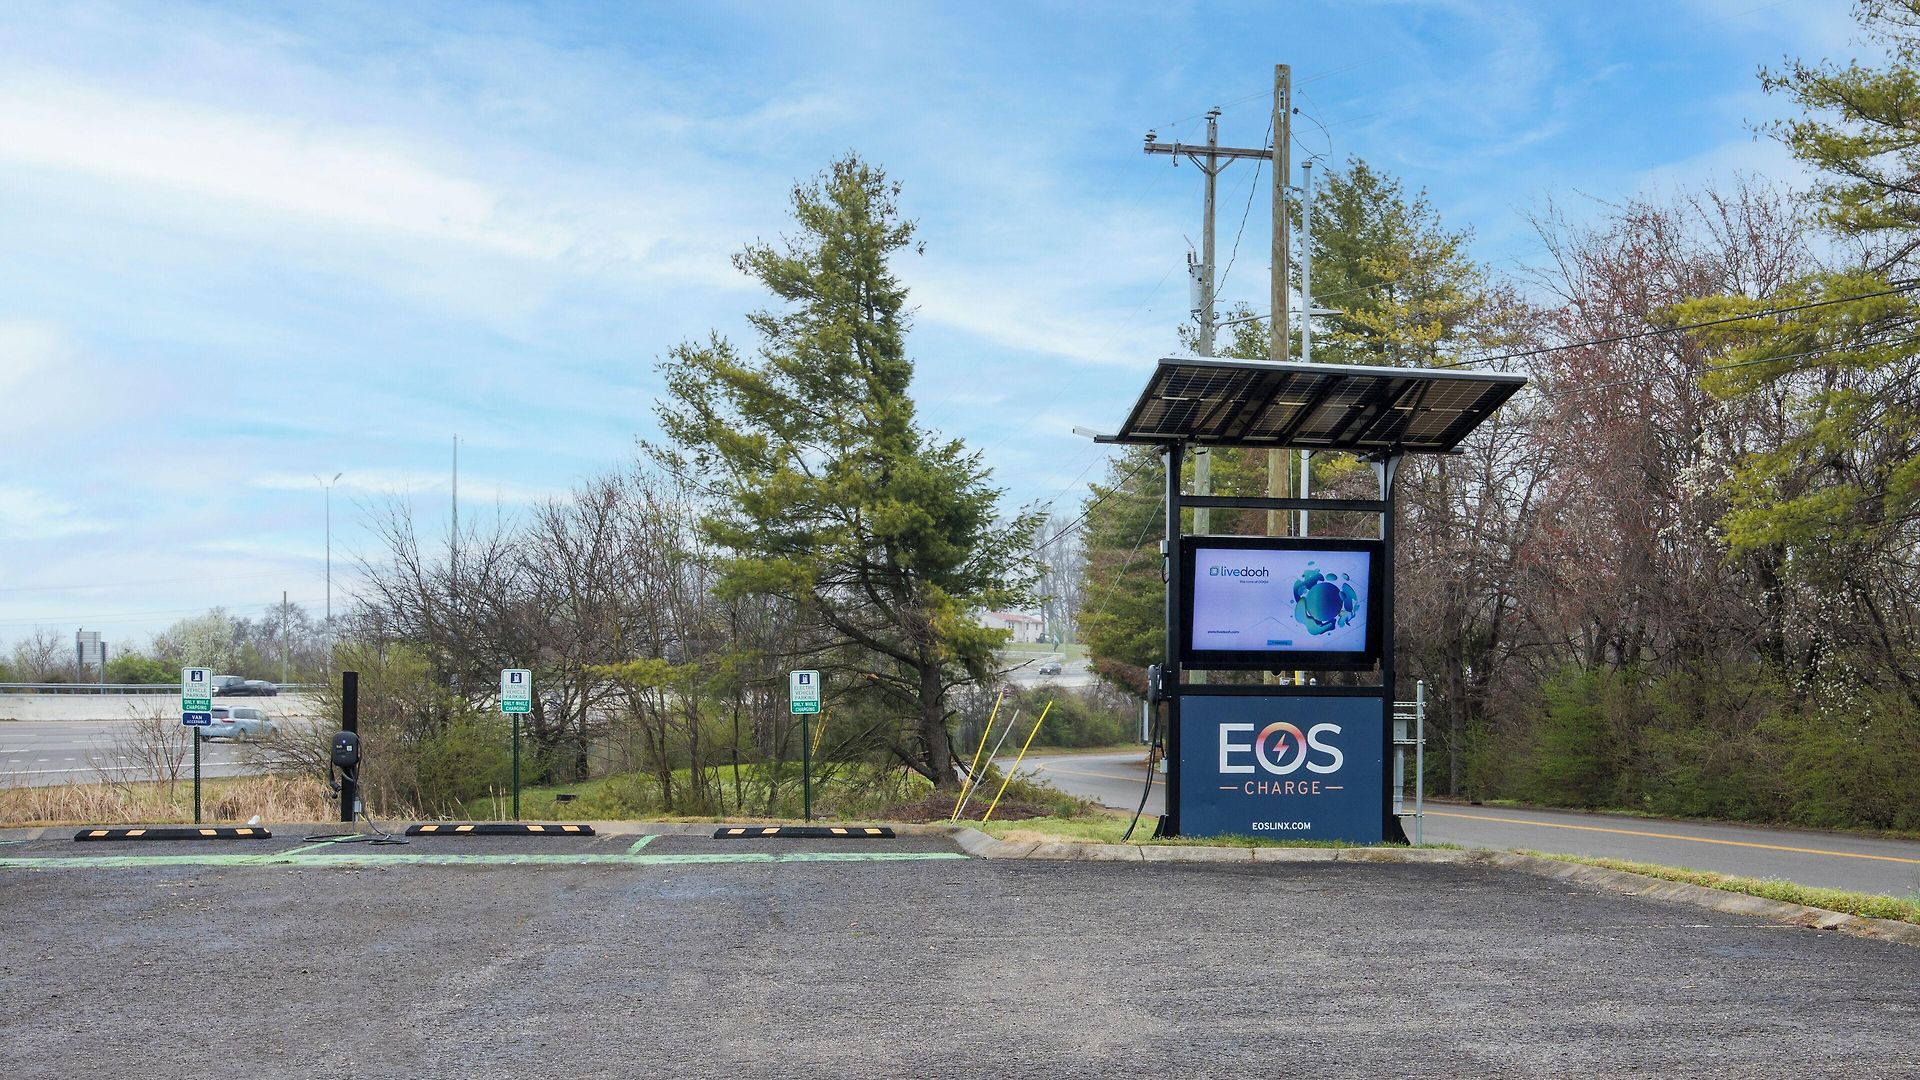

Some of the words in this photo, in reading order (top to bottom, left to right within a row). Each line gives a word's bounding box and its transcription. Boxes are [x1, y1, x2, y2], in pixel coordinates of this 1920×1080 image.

[1221, 566, 1269, 577] livedooh
[1219, 721, 1344, 775] EOS
[1244, 780, 1321, 795] CHARGE
[1252, 822, 1311, 830] EOSLINX.COM
